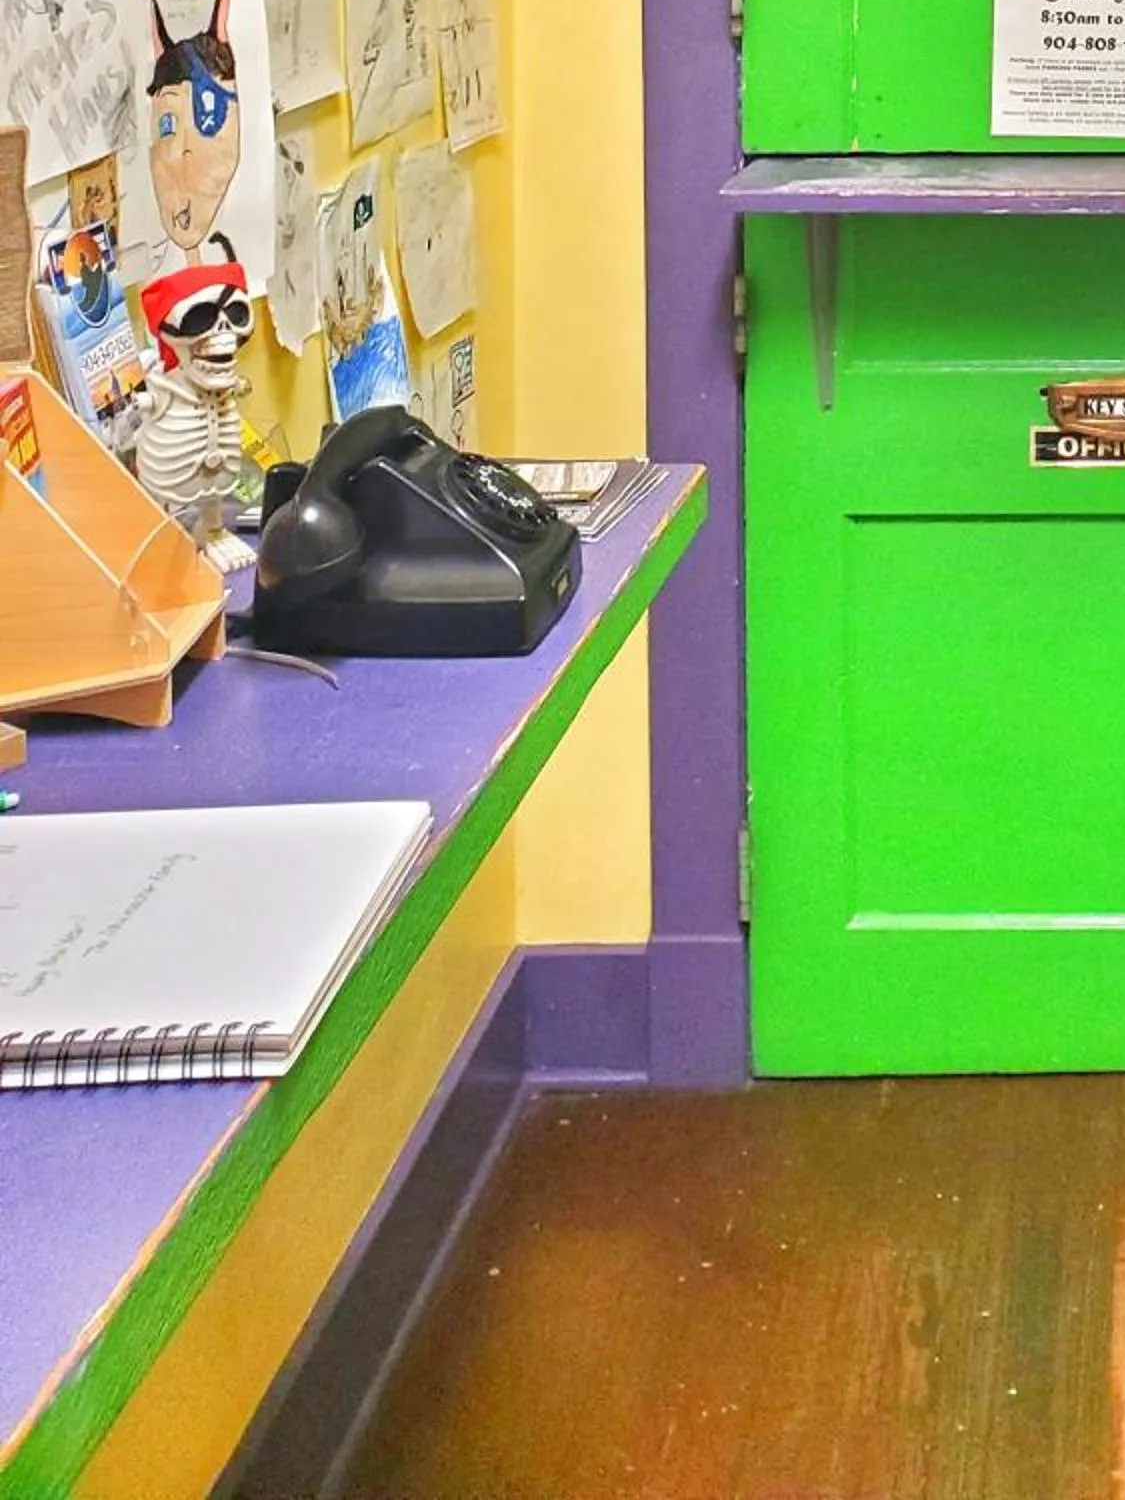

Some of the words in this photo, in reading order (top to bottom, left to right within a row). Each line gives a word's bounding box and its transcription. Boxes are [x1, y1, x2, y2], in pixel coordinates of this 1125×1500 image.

[1040, 9, 1101, 26] 8:30am
[1107, 13, 1124, 25] to
[1085, 398, 1118, 416] KEY
